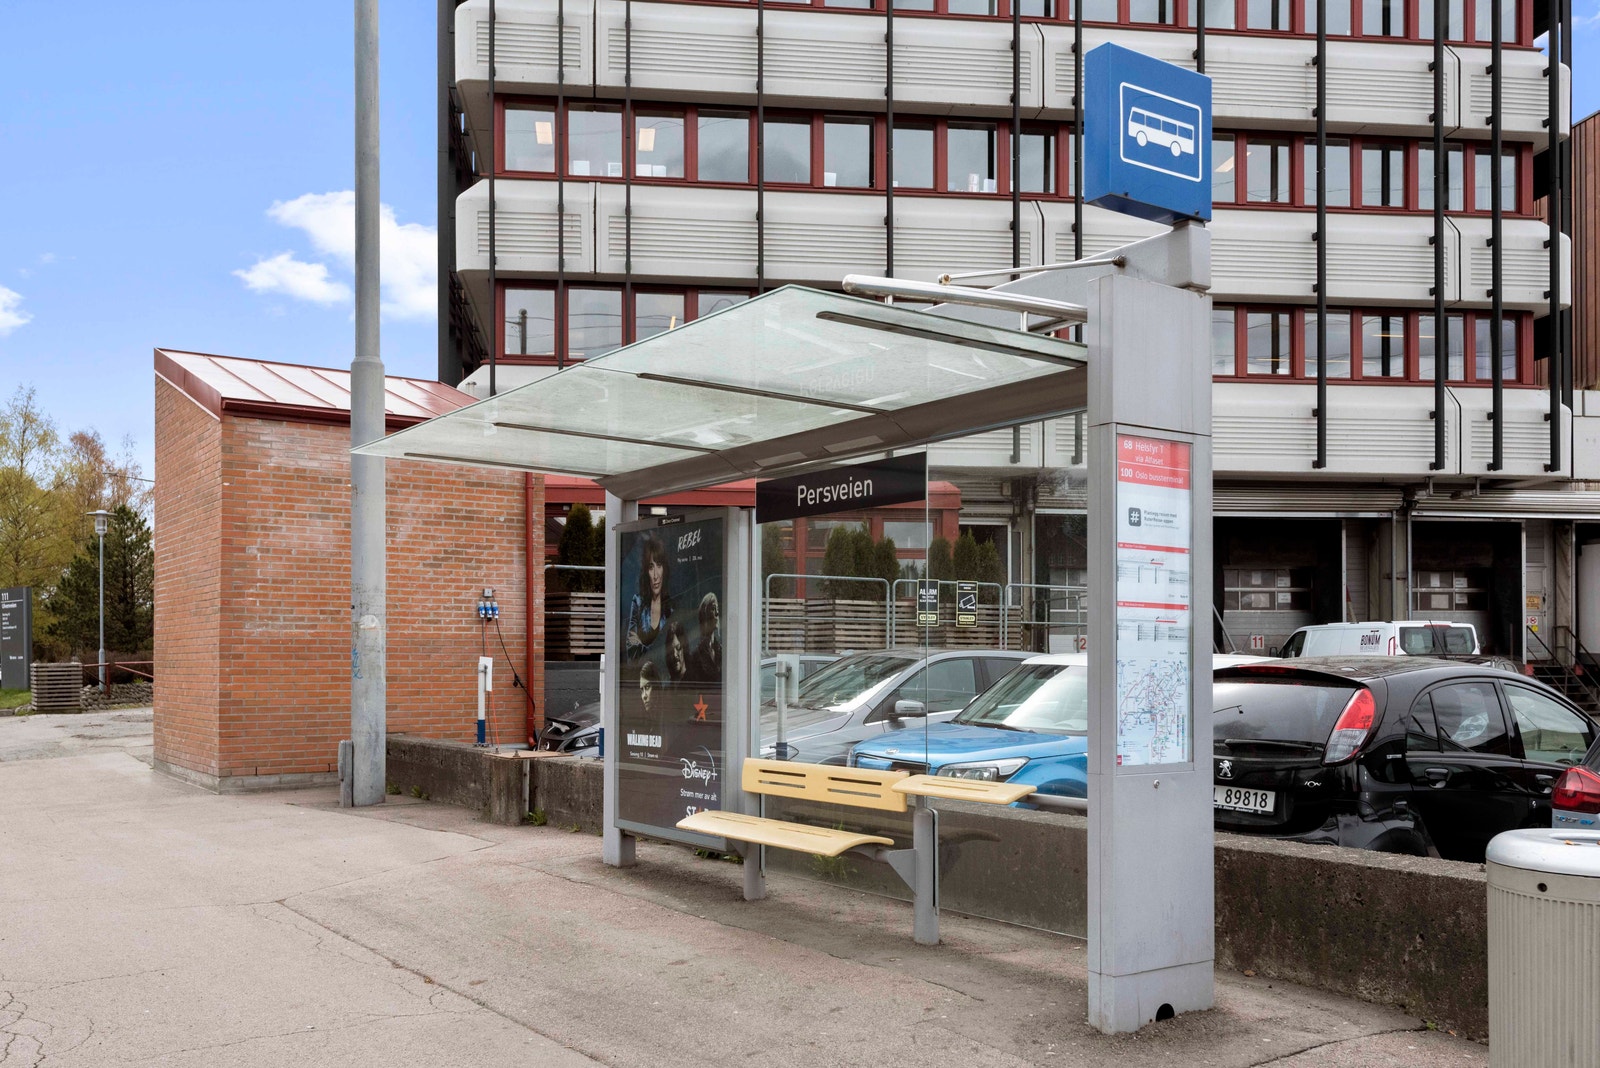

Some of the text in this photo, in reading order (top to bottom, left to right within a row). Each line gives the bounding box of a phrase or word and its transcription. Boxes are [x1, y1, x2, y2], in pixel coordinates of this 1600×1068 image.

[1124, 440, 1164, 454] 68 Helsfyr T
[1121, 468, 1184, 484] 100 Oslo bussterminal
[797, 476, 873, 507] Persveien
[677, 528, 702, 553] REBEL
[1252, 636, 1263, 648] 11
[649, 735, 662, 748] DEAD
[680, 758, 718, 787] Disney+
[680, 788, 694, 798] Strøm
[1225, 788, 1268, 808] 89818
